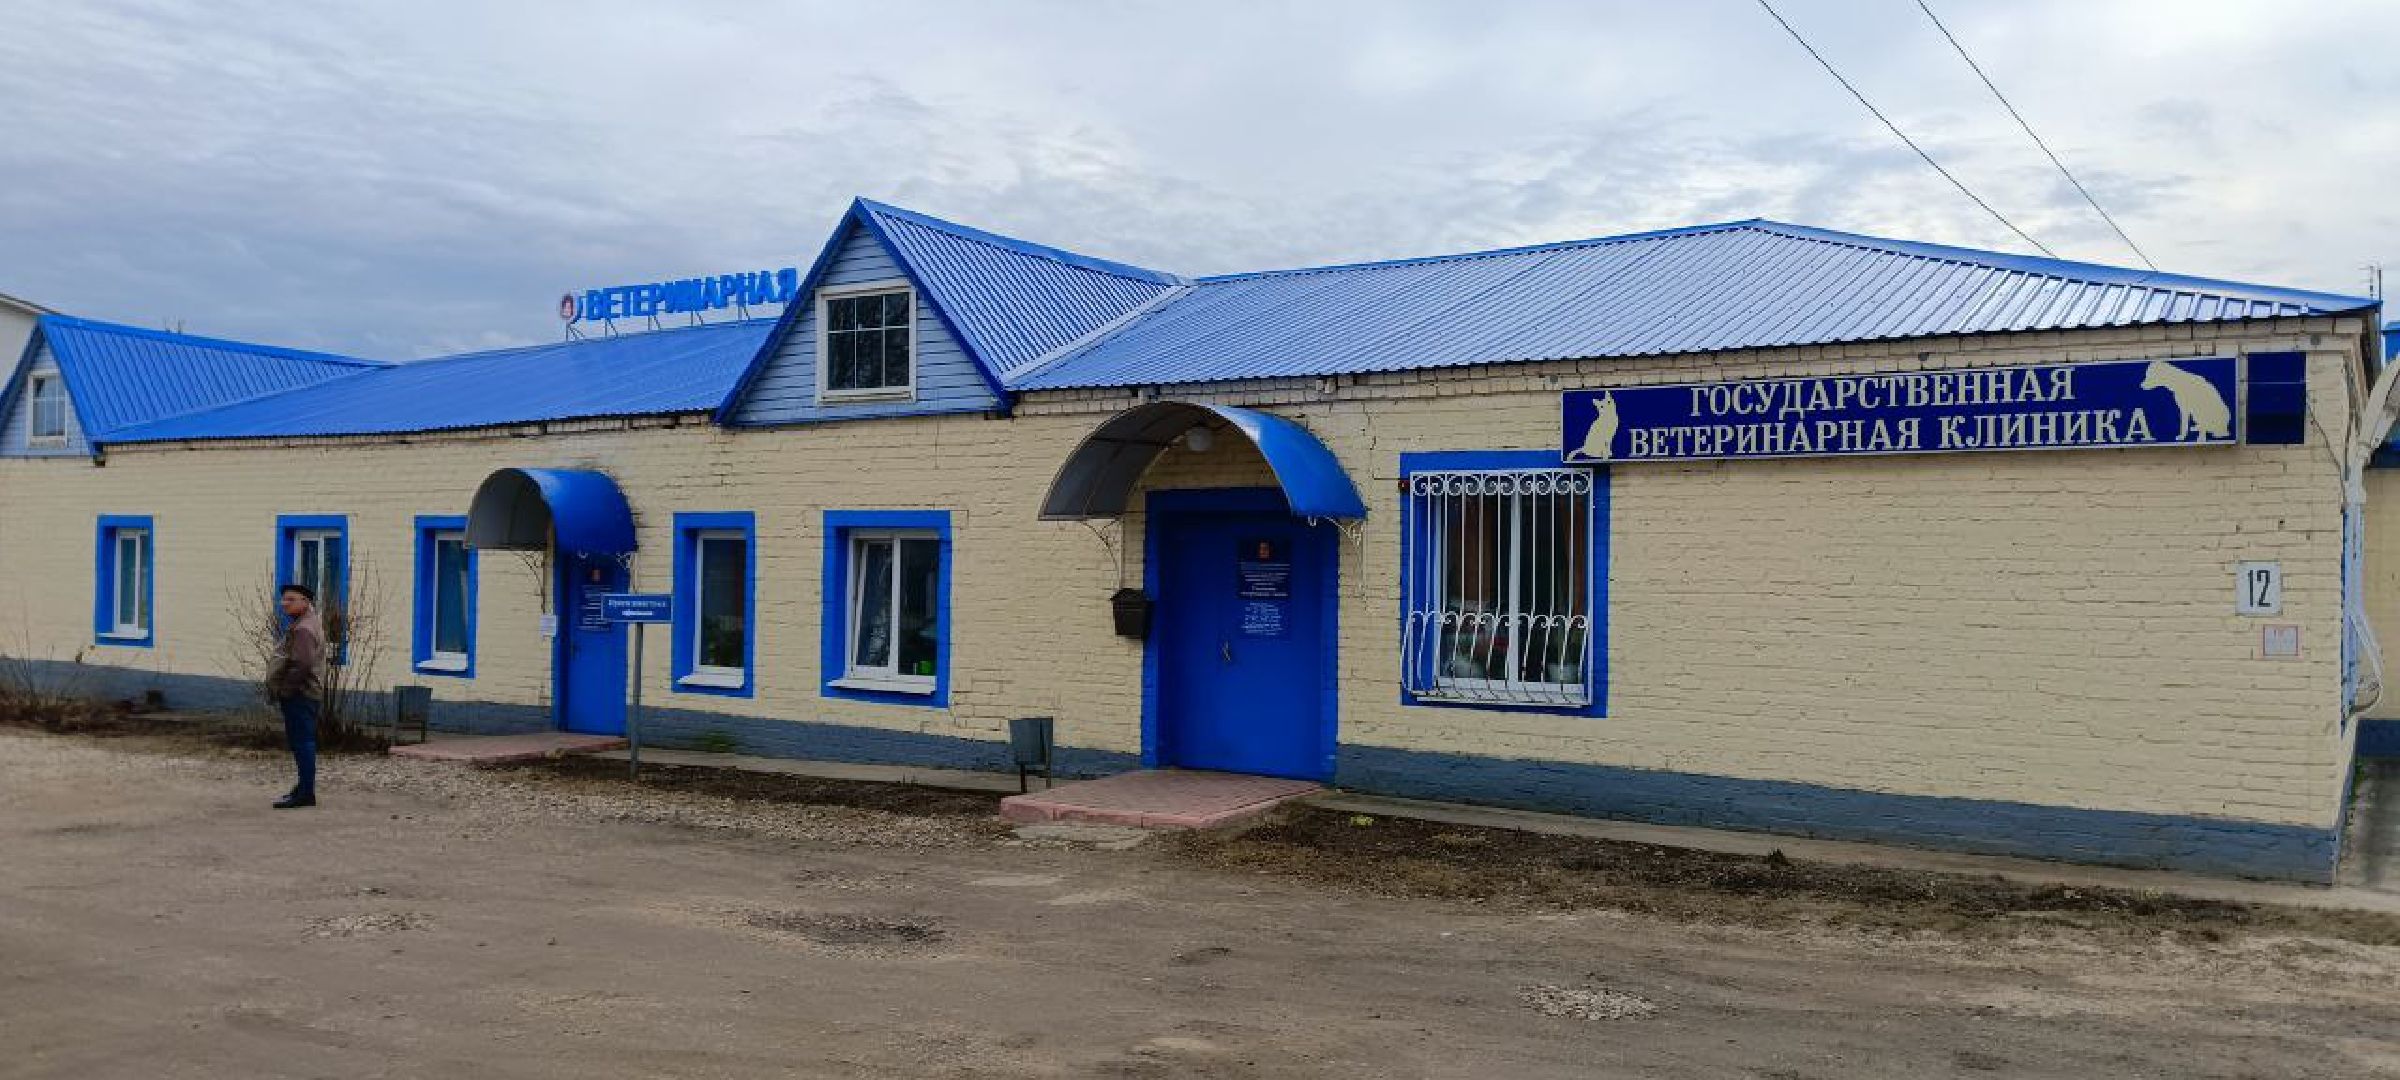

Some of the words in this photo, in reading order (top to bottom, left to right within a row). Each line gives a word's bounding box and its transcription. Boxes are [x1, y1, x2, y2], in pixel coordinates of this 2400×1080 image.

[1690, 368, 2076, 420] ГОСУДАРСТВЕННАЯ
[1629, 417, 1921, 458] ВЕТЕРИНАРНАЯ
[1937, 407, 2157, 449] КЛИНИКА
[2248, 569, 2272, 608] 12
